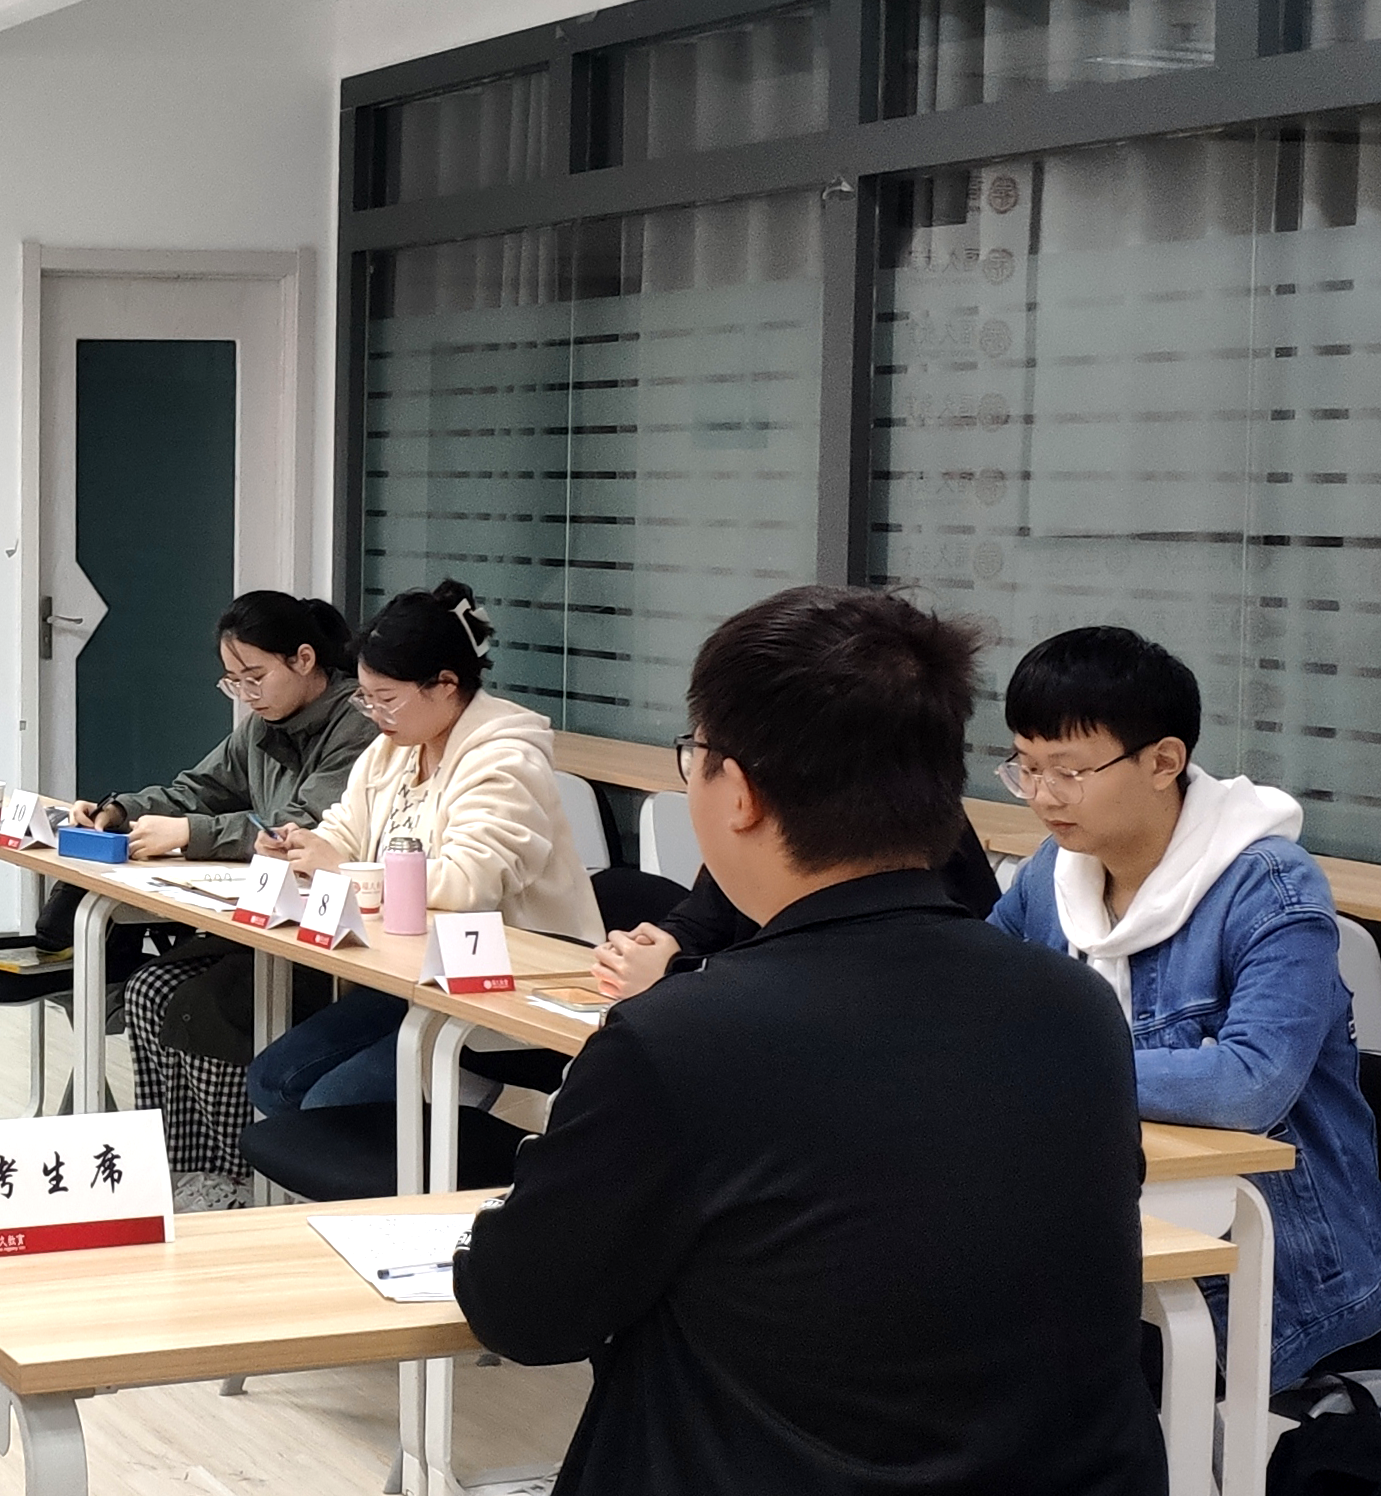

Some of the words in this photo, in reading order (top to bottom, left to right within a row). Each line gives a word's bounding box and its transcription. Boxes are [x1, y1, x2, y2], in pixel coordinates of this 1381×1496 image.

[12, 804, 26, 822] 10
[257, 873, 268, 893] 9
[319, 894, 329, 916] 8
[465, 931, 479, 955] 7
